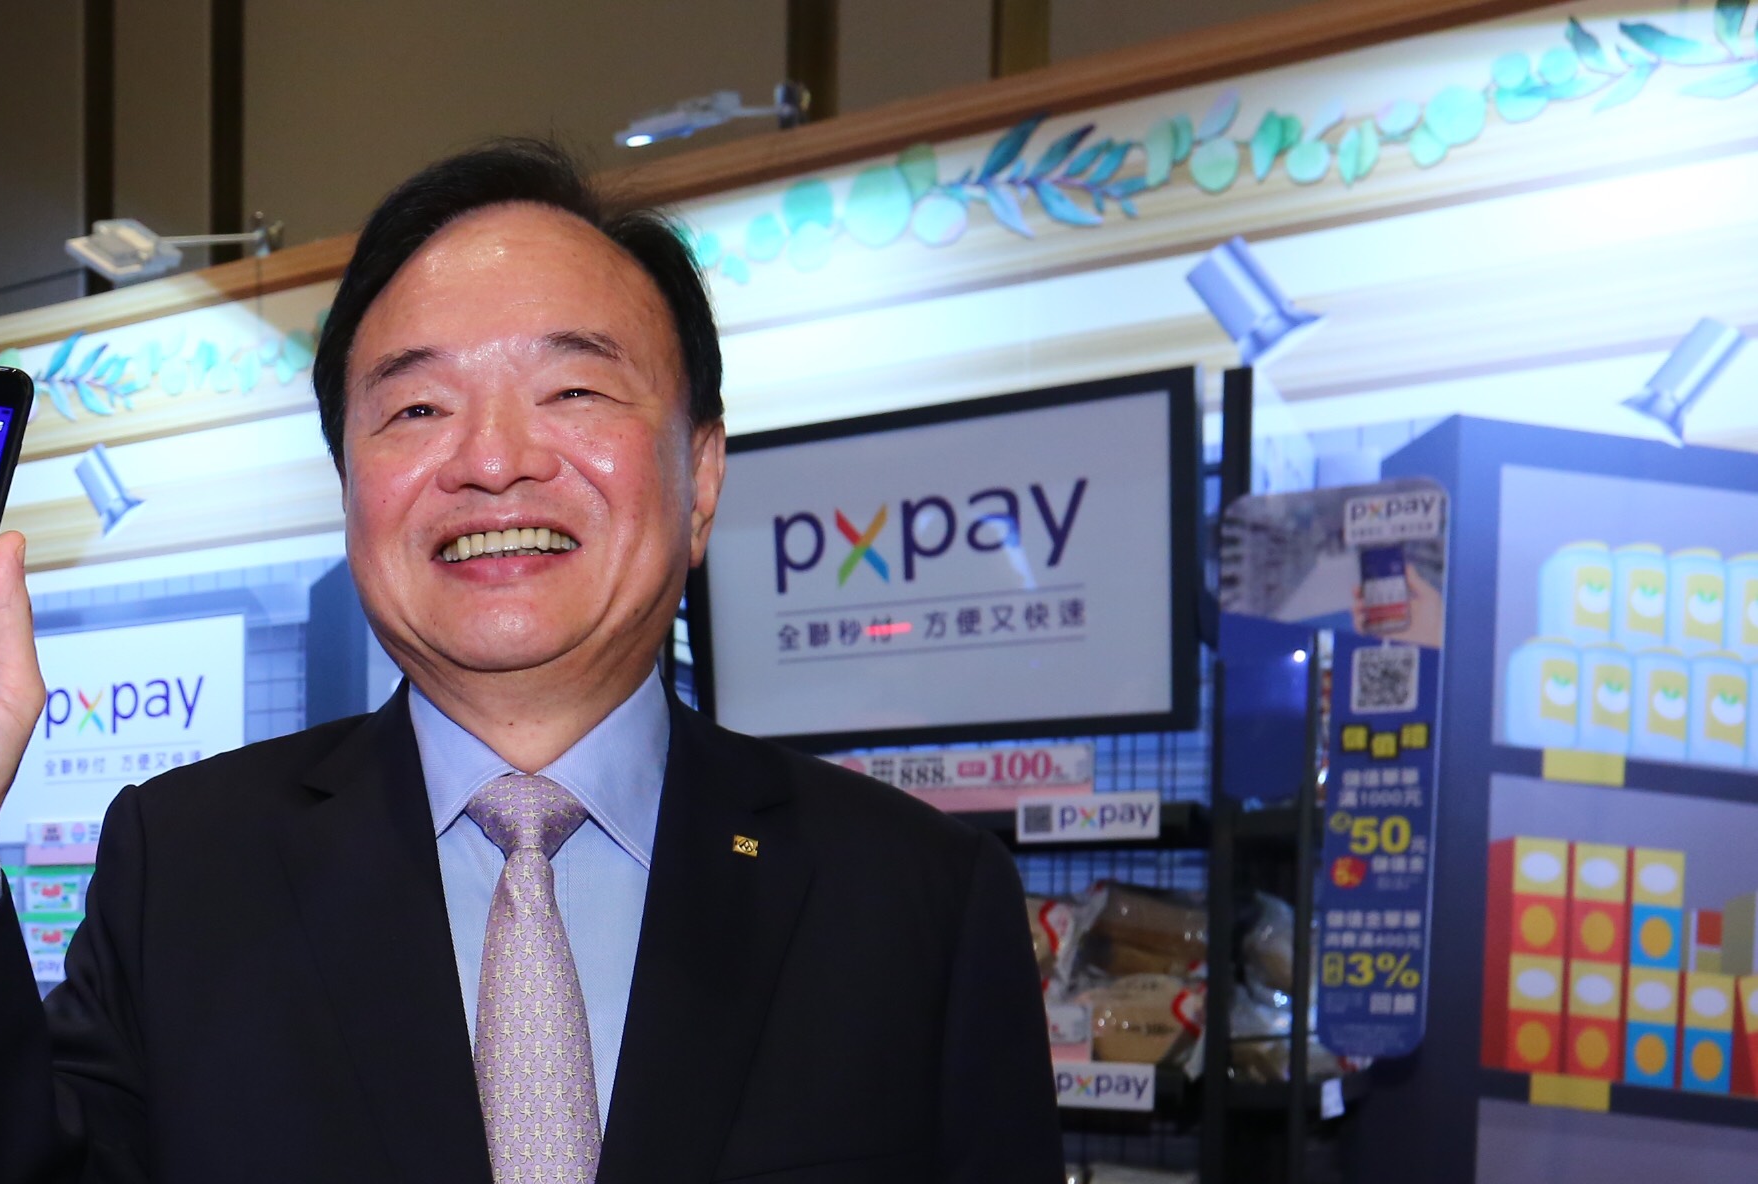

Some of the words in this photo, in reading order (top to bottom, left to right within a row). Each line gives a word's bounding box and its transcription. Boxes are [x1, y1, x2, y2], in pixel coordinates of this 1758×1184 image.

[1351, 496, 1436, 524] pxpay
[774, 478, 1088, 594] pxpay
[923, 598, 1086, 639] 方便又快速
[45, 675, 204, 739] pxpay
[992, 750, 1053, 782] 100
[1059, 801, 1154, 830] pxpay
[1347, 952, 1420, 988] 3%
[1057, 1072, 1149, 1099] pxpay
